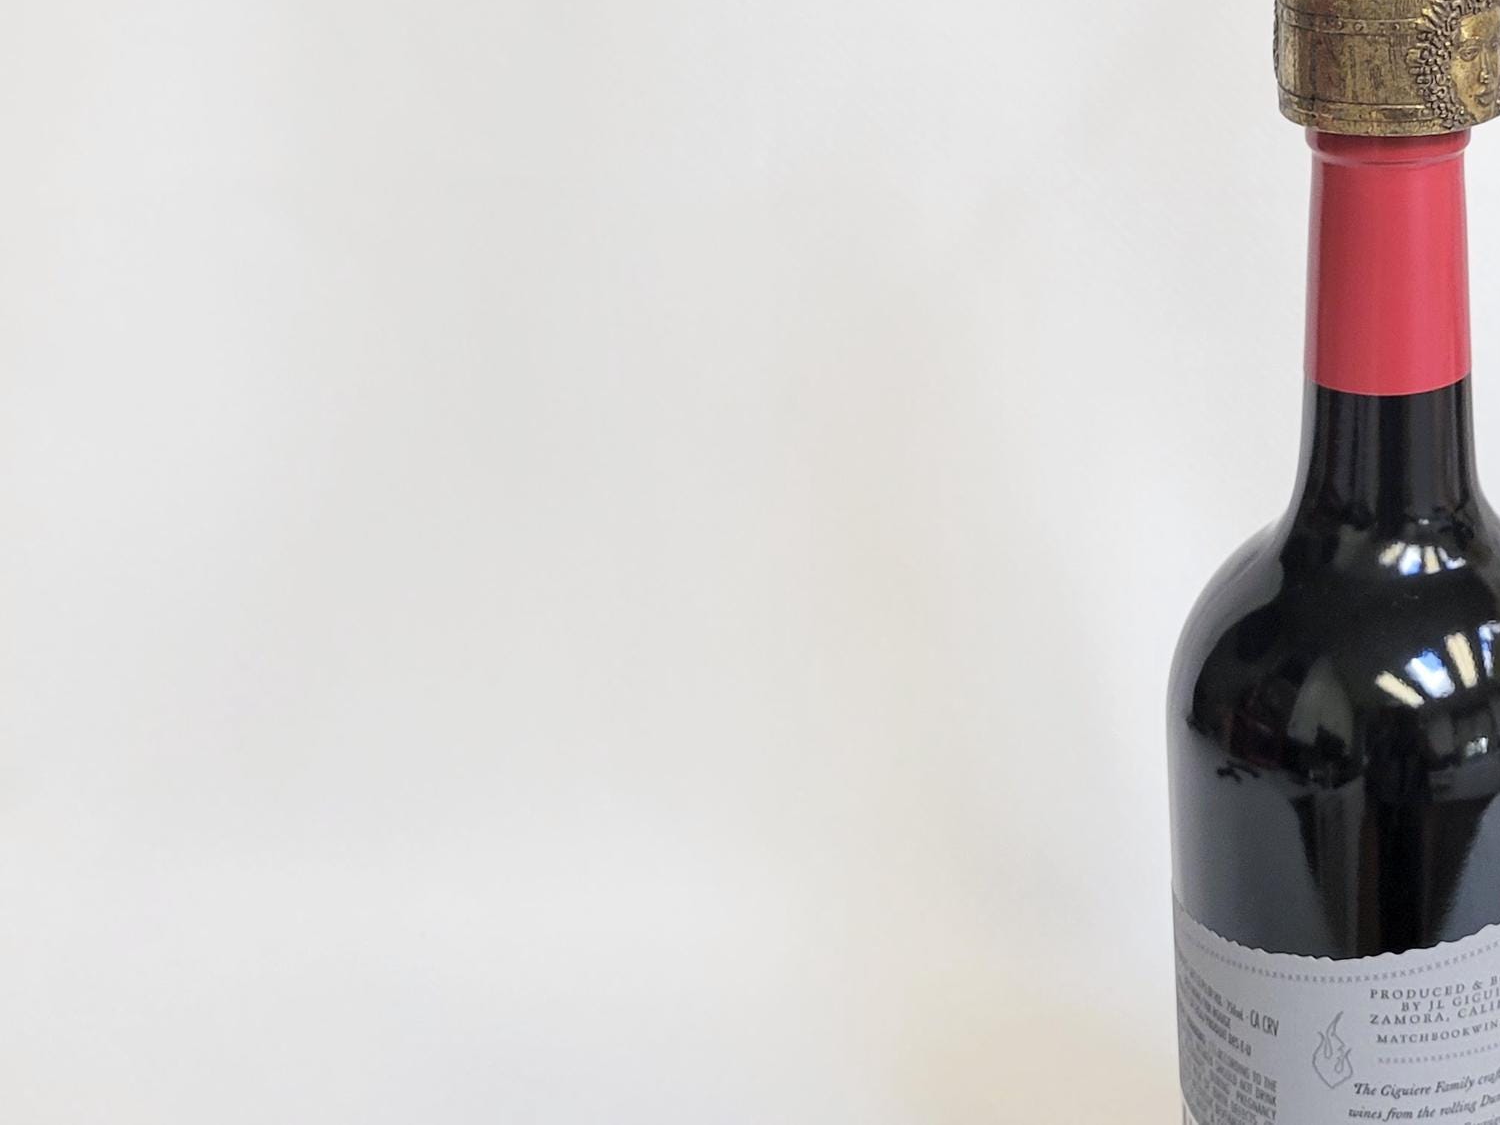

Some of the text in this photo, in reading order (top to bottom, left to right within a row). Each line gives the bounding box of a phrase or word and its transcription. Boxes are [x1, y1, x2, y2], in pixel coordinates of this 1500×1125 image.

[1370, 983, 1465, 1000] PRODUCED
[1472, 980, 1483, 991] &
[1401, 1000, 1422, 1013] BY
[1428, 999, 1445, 1012] JL
[1250, 1009, 1260, 1029] CA
[1262, 1015, 1279, 1037] CRV
[1369, 1012, 1450, 1026] ZAMORA,
[1354, 1082, 1377, 1097] The
[1380, 1083, 1431, 1100] Giguiere
[1435, 1075, 1475, 1093] Family
[1348, 1106, 1383, 1120] wines
[1382, 1107, 1413, 1123] from
[1418, 1105, 1436, 1119] the
[1439, 1100, 1477, 1116] rolling
